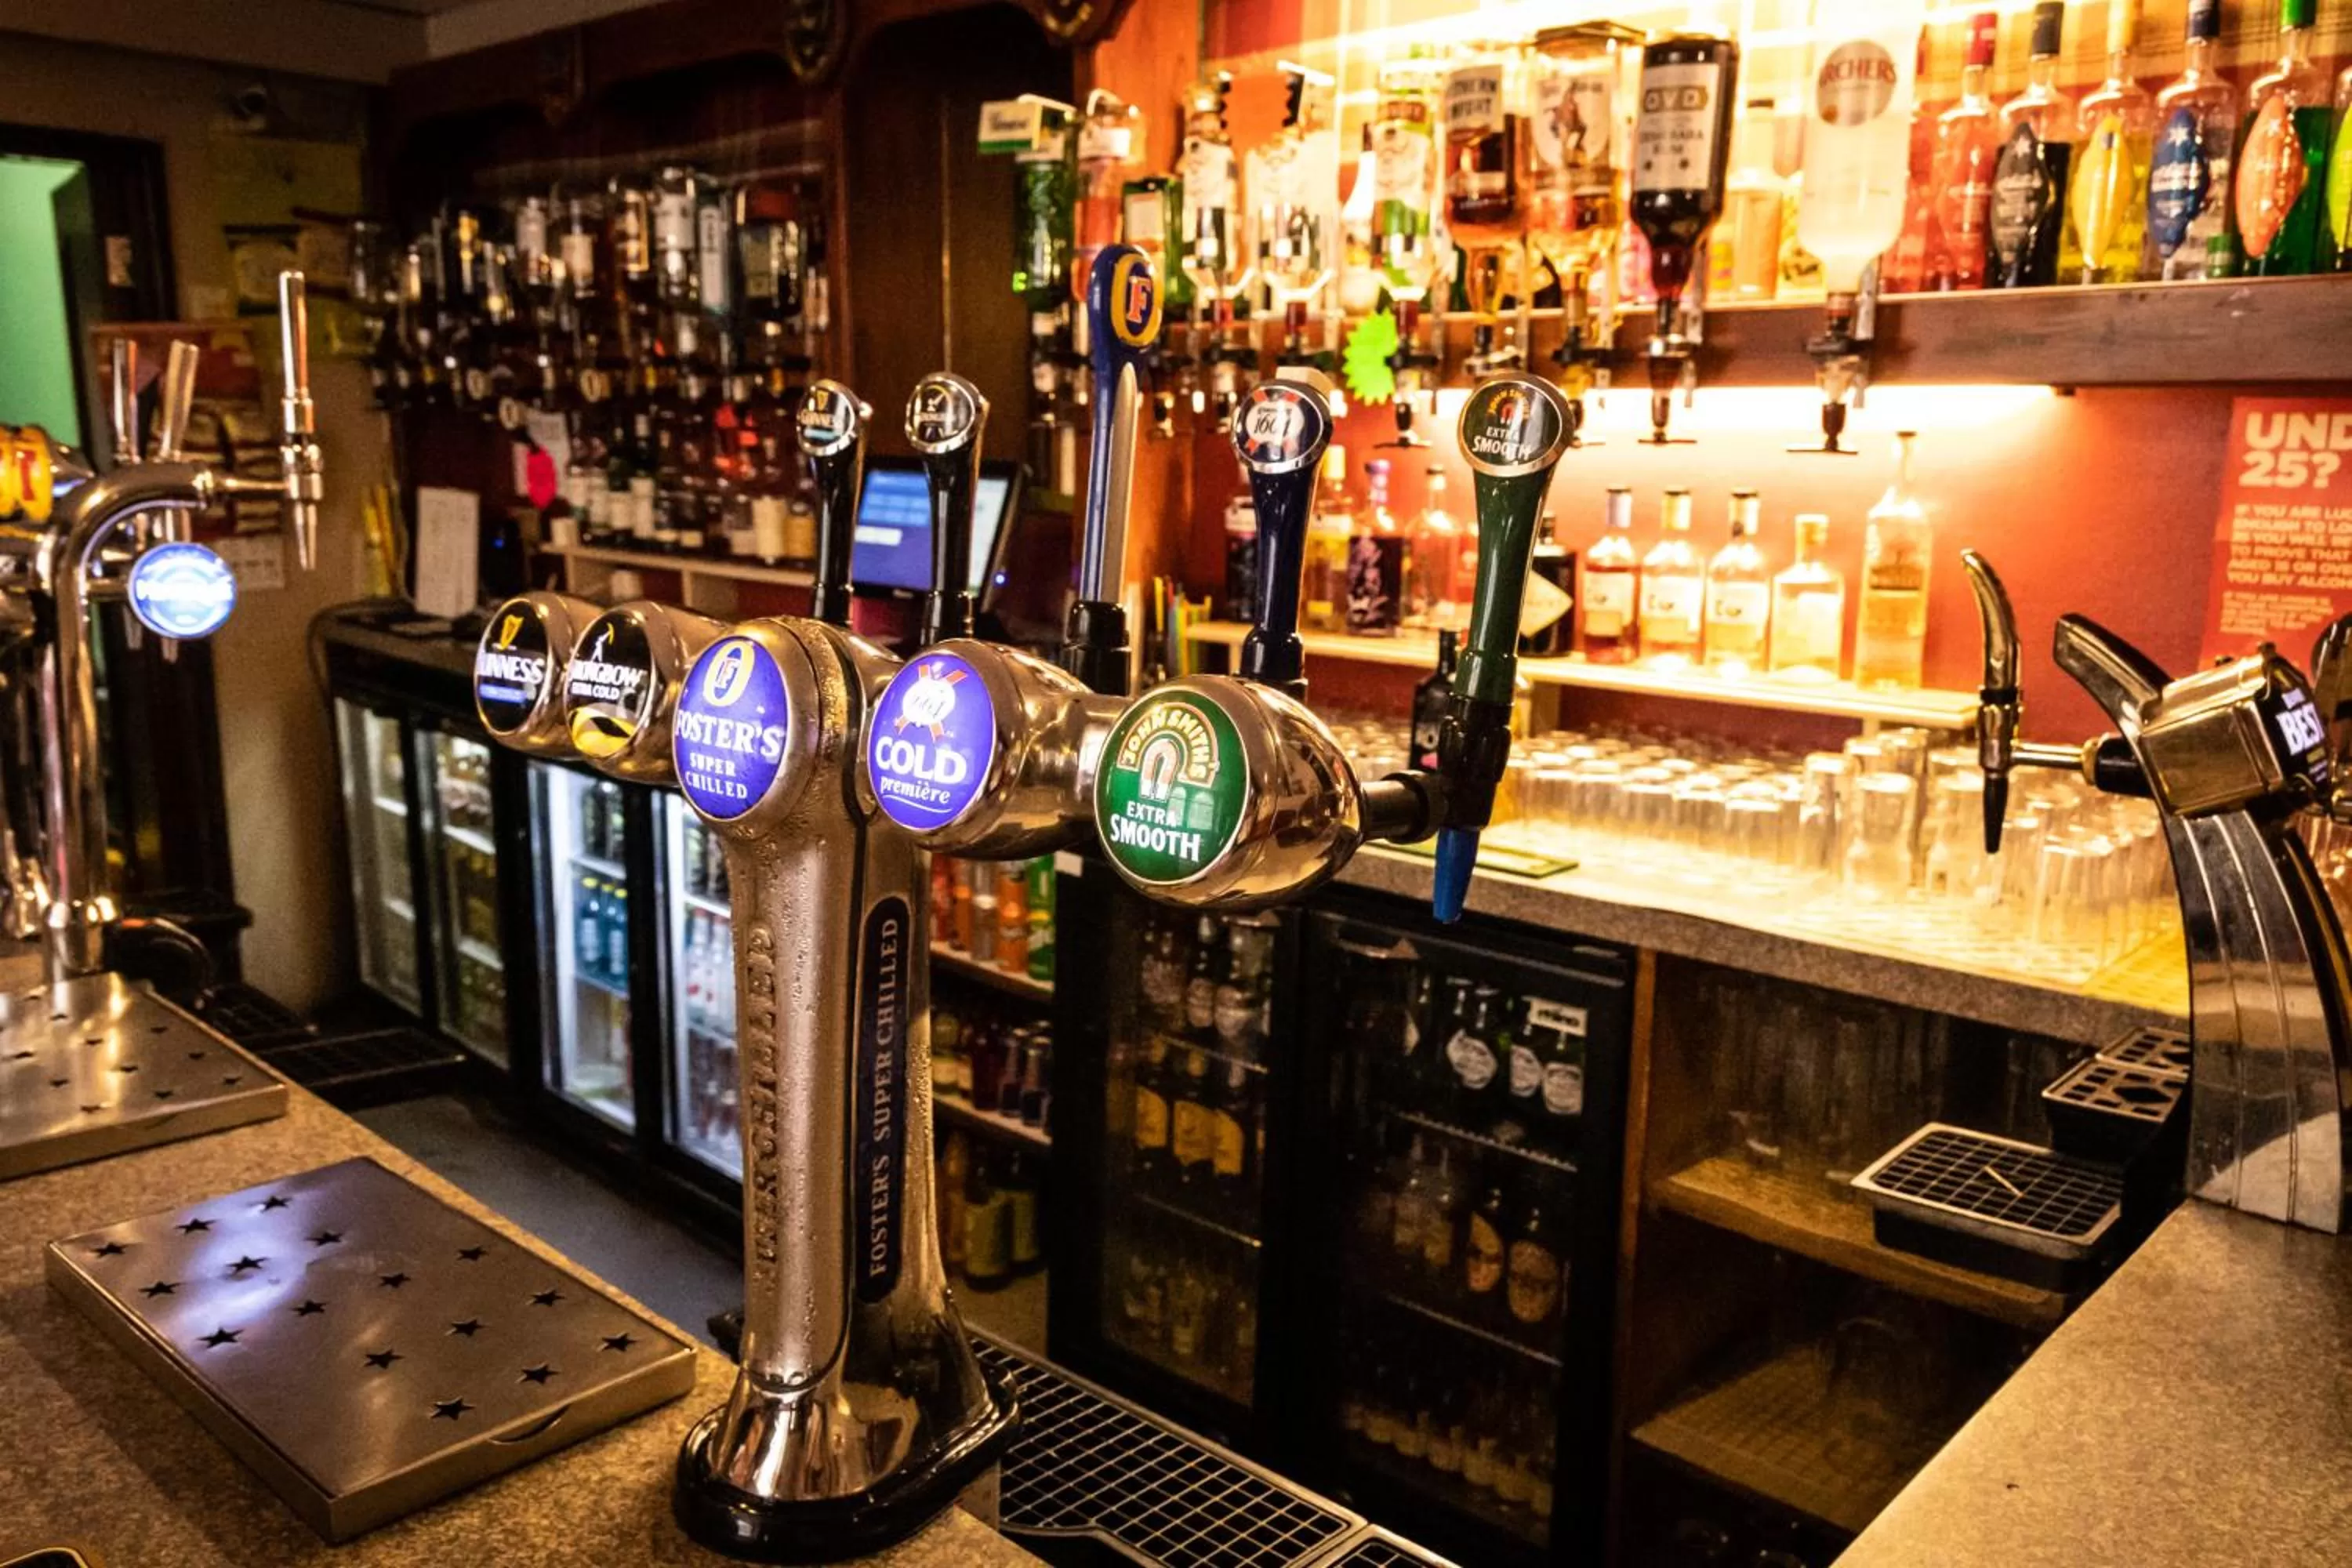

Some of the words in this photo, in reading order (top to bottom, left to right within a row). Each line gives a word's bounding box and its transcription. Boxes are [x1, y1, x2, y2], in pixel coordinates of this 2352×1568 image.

[1127, 275, 1152, 323] F
[2245, 412, 2352, 450] UND
[1472, 435, 1532, 461] SMOOTH
[2238, 450, 2341, 488] 25?
[2252, 504, 2287, 517] YOU
[2252, 532, 2287, 545] YOU
[2303, 520, 2326, 533] TO
[2254, 546, 2307, 559] PROVE
[2311, 548, 2350, 561] THAT
[2227, 571, 2259, 584] YOU
[593, 682, 620, 700] COLD
[676, 709, 785, 758] FOSTER'S
[1122, 706, 1167, 765] JOHN
[690, 752, 736, 777] SUPER
[876, 736, 967, 784] COLD
[685, 771, 748, 799] CHILLED
[880, 775, 951, 804] première
[1127, 800, 1178, 828] EXTRA
[1110, 814, 1202, 862] SMOOTH
[876, 917, 898, 1046] CHILLED
[873, 1050, 894, 1142] SUPER
[868, 1154, 891, 1277] FOSTER'S
